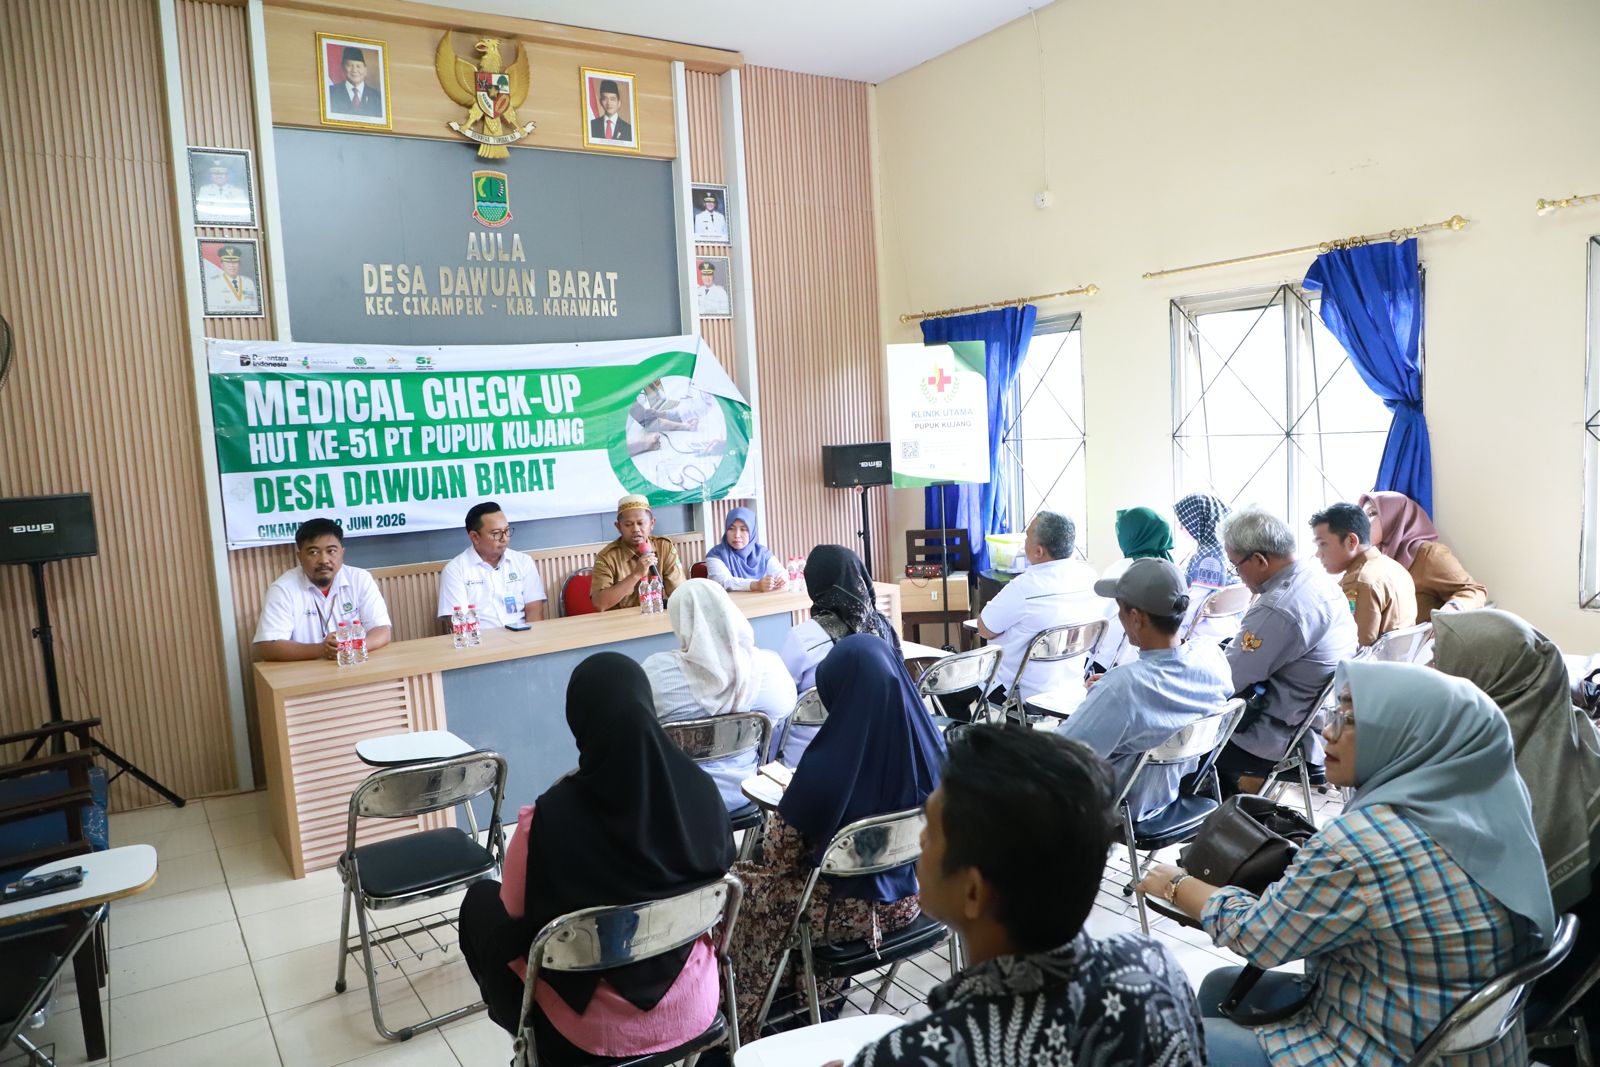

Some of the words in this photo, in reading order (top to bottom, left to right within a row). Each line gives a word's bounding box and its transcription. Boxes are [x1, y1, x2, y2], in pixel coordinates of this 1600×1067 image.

[466, 231, 526, 262] AULA
[363, 263, 428, 295] DESA
[439, 265, 536, 298] DAWUAN
[548, 269, 618, 299] BARAT
[365, 296, 399, 315] KEC.
[402, 296, 484, 315] CIKAMPEK
[506, 298, 538, 315] KAB.
[543, 298, 618, 317] KARAWANG
[243, 379, 415, 427] MEDICAL
[422, 374, 582, 420] CHECK-UP
[911, 410, 940, 418] KLINIK
[943, 408, 973, 416] UTAMA
[914, 422, 939, 430] PUPUK
[941, 420, 972, 428] KUJANG
[249, 431, 298, 465] HUT
[307, 428, 379, 461] KE-51
[384, 426, 413, 457] PT
[421, 422, 496, 455] PUPUK
[502, 417, 585, 450] KUJANG
[253, 473, 335, 514] DESA
[343, 464, 467, 507] DAWUAN
[474, 458, 556, 496] BARAT
[347, 515, 372, 531] JUNI
[375, 513, 406, 528] 2026
